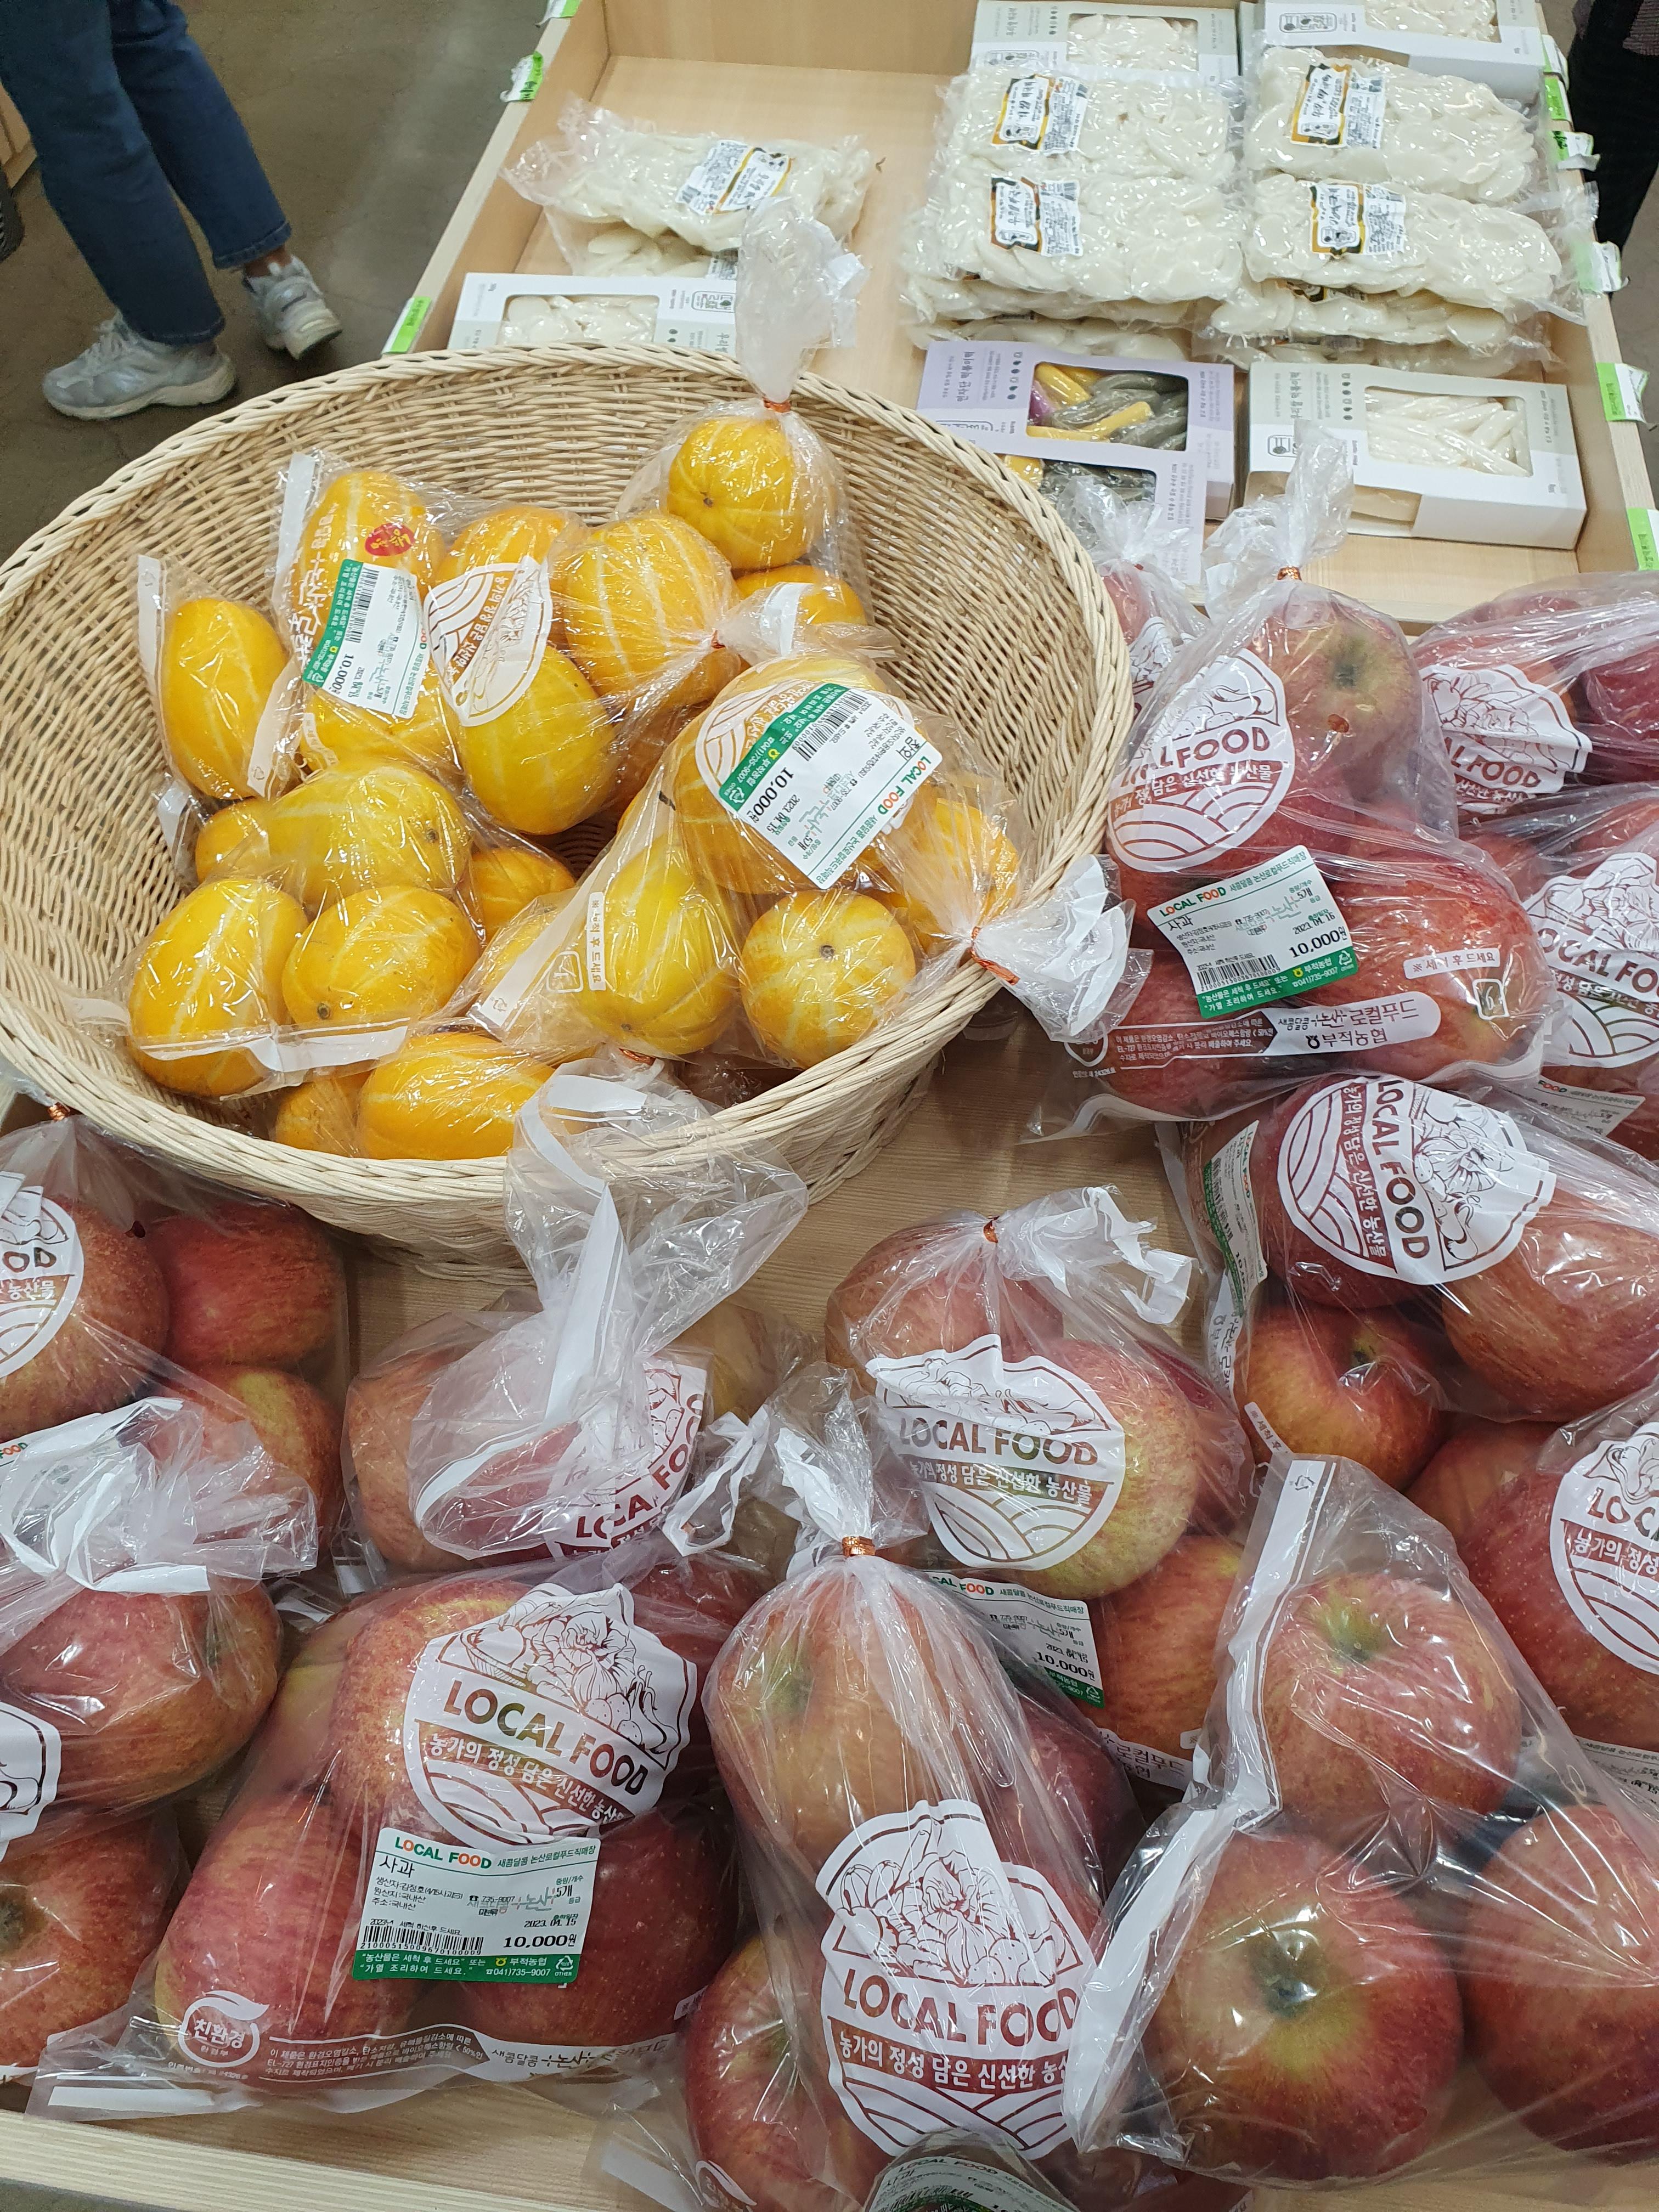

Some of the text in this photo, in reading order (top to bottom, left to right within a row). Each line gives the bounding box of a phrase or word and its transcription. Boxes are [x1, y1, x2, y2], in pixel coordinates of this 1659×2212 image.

[487, 574, 510, 605] 농가의
[469, 621, 488, 642] 담은
[454, 640, 476, 668] 신선한
[896, 735, 921, 760] 참외
[1176, 727, 1270, 769] FOOD
[901, 755, 930, 788] LOCAL
[1467, 754, 1542, 788] FOOD
[746, 767, 795, 822] 10,000원
[876, 785, 904, 816] FOOD
[1159, 899, 1197, 917] LOCAL
[1196, 887, 1226, 903] FOOD
[1168, 916, 1194, 932] 사과
[1289, 926, 1347, 958] 10,000원
[1538, 927, 1612, 978] OCAL
[1452, 951, 1496, 966] 후 드세요
[1278, 1015, 1310, 1031] 새콤달콤
[1350, 998, 1419, 1026] 로컬푸드
[1322, 1028, 1387, 1047] 부적농협
[1342, 1137, 1367, 1167] 담은
[1362, 1079, 1431, 1262] LOCAL FOOD
[1351, 1168, 1378, 1213] 신선한
[1363, 1215, 1386, 1259] 농산물
[7, 1279, 57, 1300] 농산물
[900, 1417, 1099, 1466] LOCAL FOOD
[936, 1463, 958, 1484] 정성
[961, 1465, 991, 1487] 담은
[1045, 1479, 1093, 1505] 농산물
[959, 1583, 995, 1596] FOOD
[1037, 1651, 1096, 1681] 10,000원
[442, 1679, 649, 1796] LOCAL FOOD
[429, 1733, 596, 1813] 농가의 정성 담은 신선한
[1116, 1742, 1186, 1778] 로컬푸드
[379, 1855, 415, 1878] 사과
[395, 1837, 596, 1869] LOCAL FOOD 새콤달콤 논산로컬푸드직매장
[371, 1897, 416, 1911] 주소:국내산
[374, 1887, 426, 1903] 원산지:국내산
[556, 1885, 572, 1897] 5개
[566, 1918, 576, 1926] 15
[503, 1934, 577, 1948] 10,000원
[390, 1963, 428, 1973] 조리하여
[403, 1954, 421, 1963] 세척
[423, 1956, 432, 1964] 후
[510, 1957, 547, 1966] 부적농협
[843, 1968, 967, 2042] LOCAL
[194, 2018, 246, 2049] 친환경
[267, 2059, 295, 2068] EL-727
[270, 2049, 279, 2057] 이
[492, 2047, 538, 2068] 새콤달콤
[839, 2031, 1035, 2090] 농가의 정성 담은 신선한
